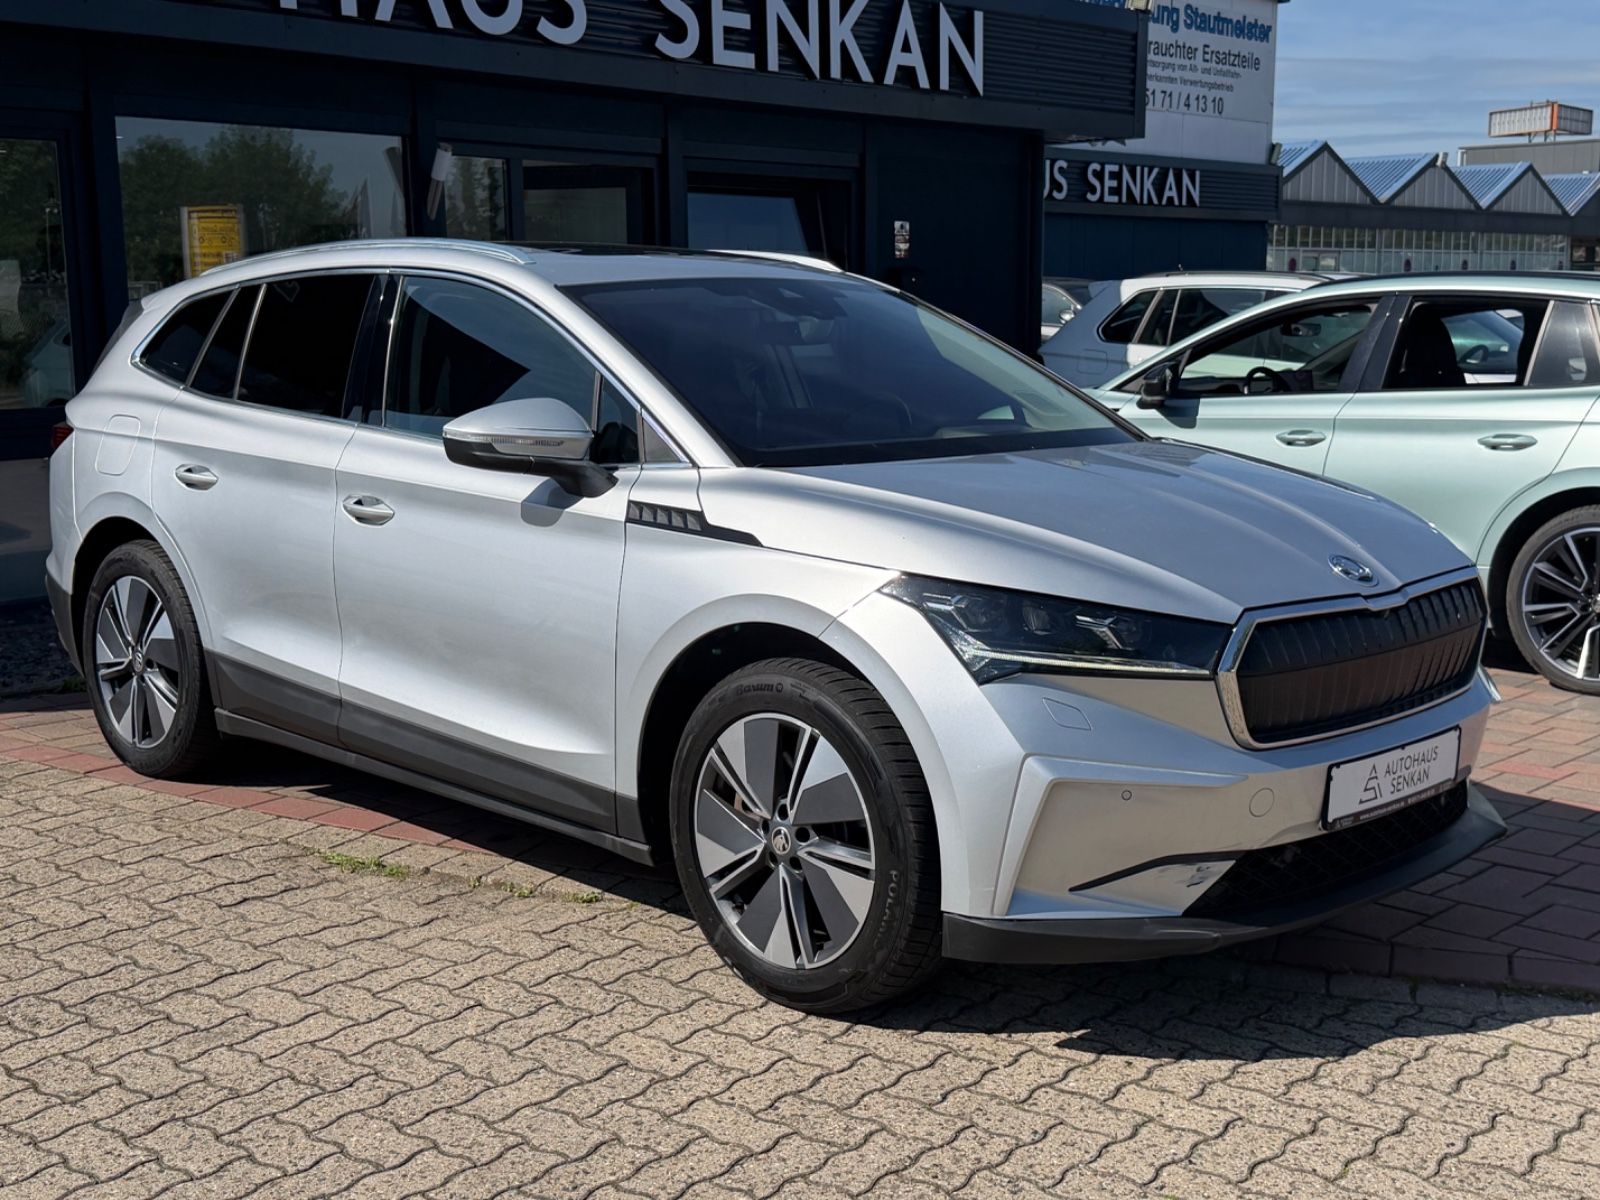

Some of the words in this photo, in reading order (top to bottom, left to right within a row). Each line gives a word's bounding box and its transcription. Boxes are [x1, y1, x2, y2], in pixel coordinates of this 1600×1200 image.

[1148, 4, 1180, 33] ung
[655, 0, 983, 97] SENKAN
[1202, 44, 1260, 71] Ersatzteile
[1086, 162, 1200, 207] SENKAN
[1384, 745, 1439, 778] AUTOHAUS
[1390, 766, 1431, 795] SENKAN
